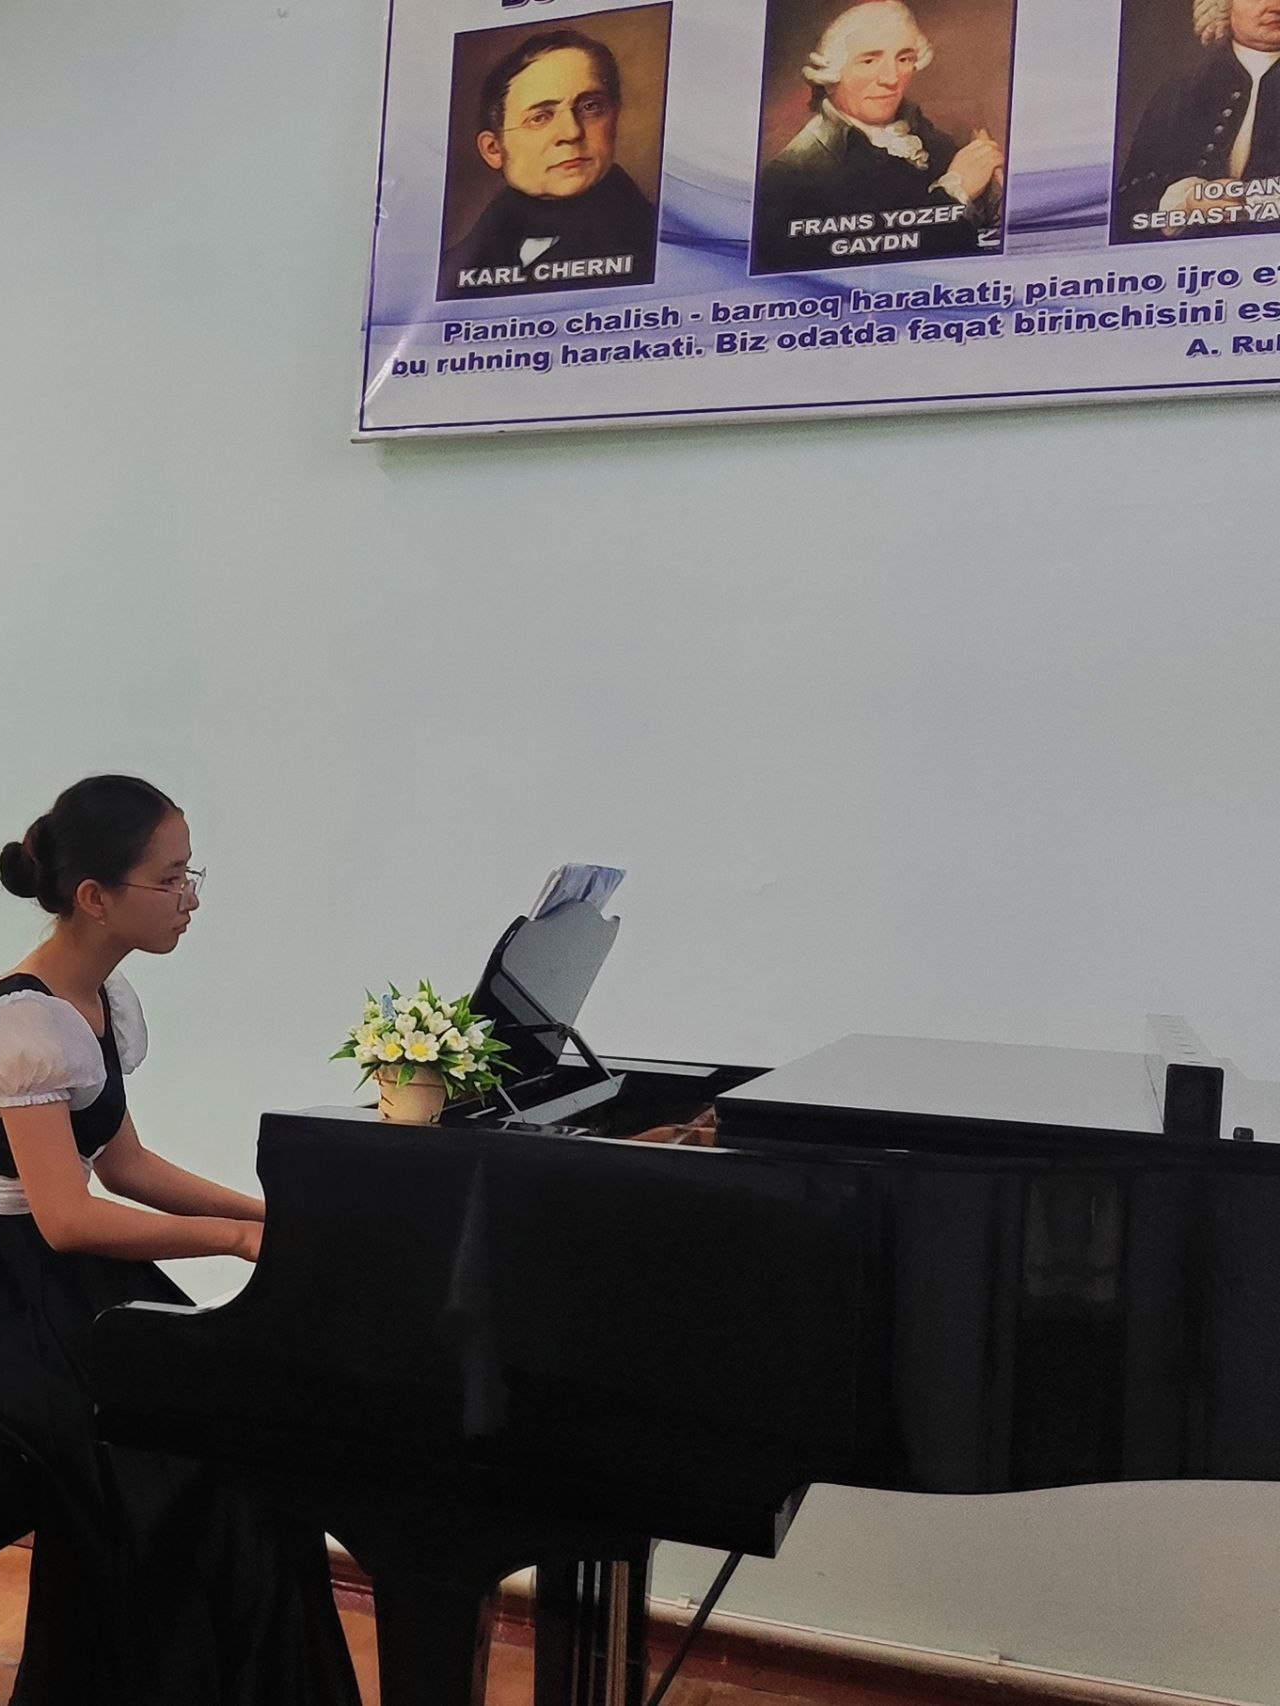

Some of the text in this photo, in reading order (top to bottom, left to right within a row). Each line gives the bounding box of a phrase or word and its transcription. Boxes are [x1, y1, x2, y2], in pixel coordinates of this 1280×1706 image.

[790, 205, 965, 236] FRANS YOZEF
[831, 233, 919, 255] GAYDN
[458, 255, 633, 287] KARL CHERNI
[444, 318, 555, 342] Pianino
[566, 306, 679, 333] chalish
[712, 296, 839, 322] barmoq
[852, 280, 1013, 310] harakati;
[1026, 272, 1163, 305] pianino
[1177, 266, 1239, 294] ijro
[1253, 266, 1280, 284] e
[392, 359, 426, 375] bu
[437, 351, 550, 371] ruhning
[561, 337, 704, 365] harakati.
[716, 331, 766, 354] Biz
[778, 324, 895, 349] odatda
[909, 314, 1002, 343] faqat
[1015, 300, 1224, 333] birinchisini
[1186, 339, 1219, 356] A.
